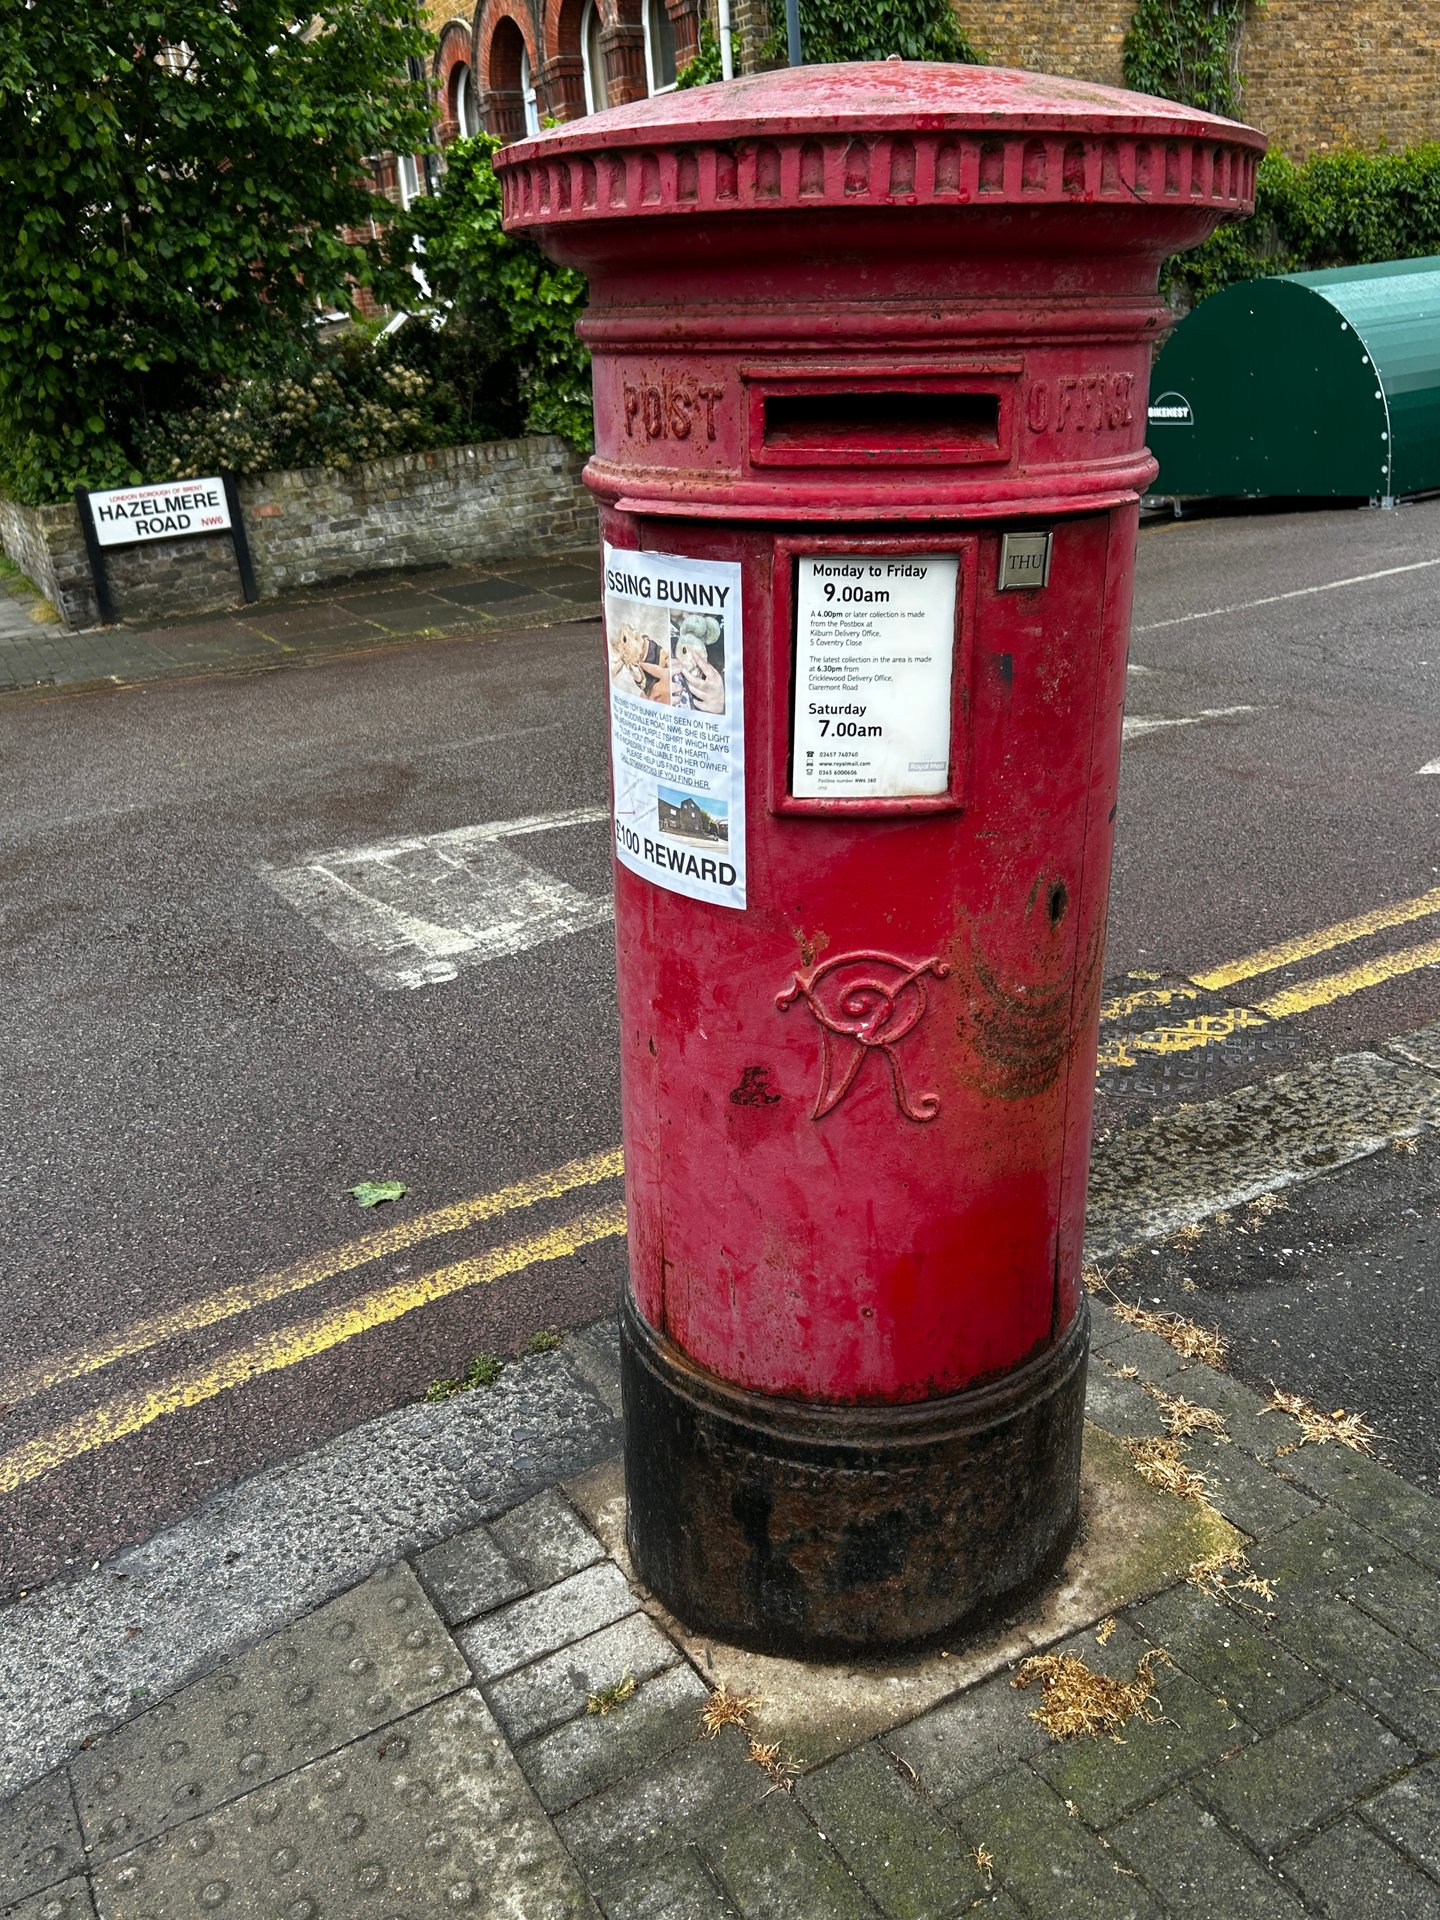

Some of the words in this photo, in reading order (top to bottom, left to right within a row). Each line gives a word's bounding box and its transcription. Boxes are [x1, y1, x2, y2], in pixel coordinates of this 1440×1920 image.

[623, 384, 724, 441] POST
[109, 493, 137, 503] LONDON
[139, 489, 171, 499] BOROUGH
[172, 487, 181, 495] OF
[183, 484, 202, 493] BRENT
[98, 491, 220, 522] HAZELMERE
[135, 514, 191, 536] ROAD
[201, 516, 224, 527] NW6
[1009, 554, 1043, 570] THU
[813, 564, 865, 580] Monday
[869, 566, 882, 577] to
[887, 565, 928, 580] Friday
[606, 570, 651, 598] SSING
[657, 578, 730, 608] BUNNY
[823, 582, 891, 603] 9.00am
[810, 610, 816, 618] A
[817, 610, 843, 619] 4.00pm
[869, 610, 899, 618] collection
[810, 620, 826, 628] from
[827, 620, 838, 628] the
[839, 620, 865, 628] Postbox
[834, 630, 860, 638] Delivery
[862, 630, 882, 638] Office,
[816, 639, 844, 647] Coventry
[842, 656, 871, 664] collection
[816, 665, 843, 674] 6.30pm
[808, 674, 846, 682] Cricklewood
[847, 674, 873, 683] Delivery
[874, 674, 894, 682] Office,
[808, 703, 867, 717] Saturday
[659, 712, 673, 723] LAST
[673, 716, 692, 727] SEEN
[693, 719, 704, 729] ON
[705, 722, 719, 732] THE
[818, 720, 883, 737] 7.00am
[684, 728, 699, 738] SHE
[700, 731, 707, 740] IS
[707, 734, 730, 744] LIGHT
[671, 744, 678, 753] IS
[685, 738, 708, 750] WHICH
[709, 743, 730, 753] SAYS
[656, 760, 666, 769] US
[666, 762, 680, 773] FIND
[674, 755, 683, 764] TO
[684, 758, 699, 768] HER
[818, 760, 871, 768] www.royalmail.com
[677, 775, 693, 786] FIND
[616, 819, 640, 855] £100
[644, 837, 737, 886] REWARD
